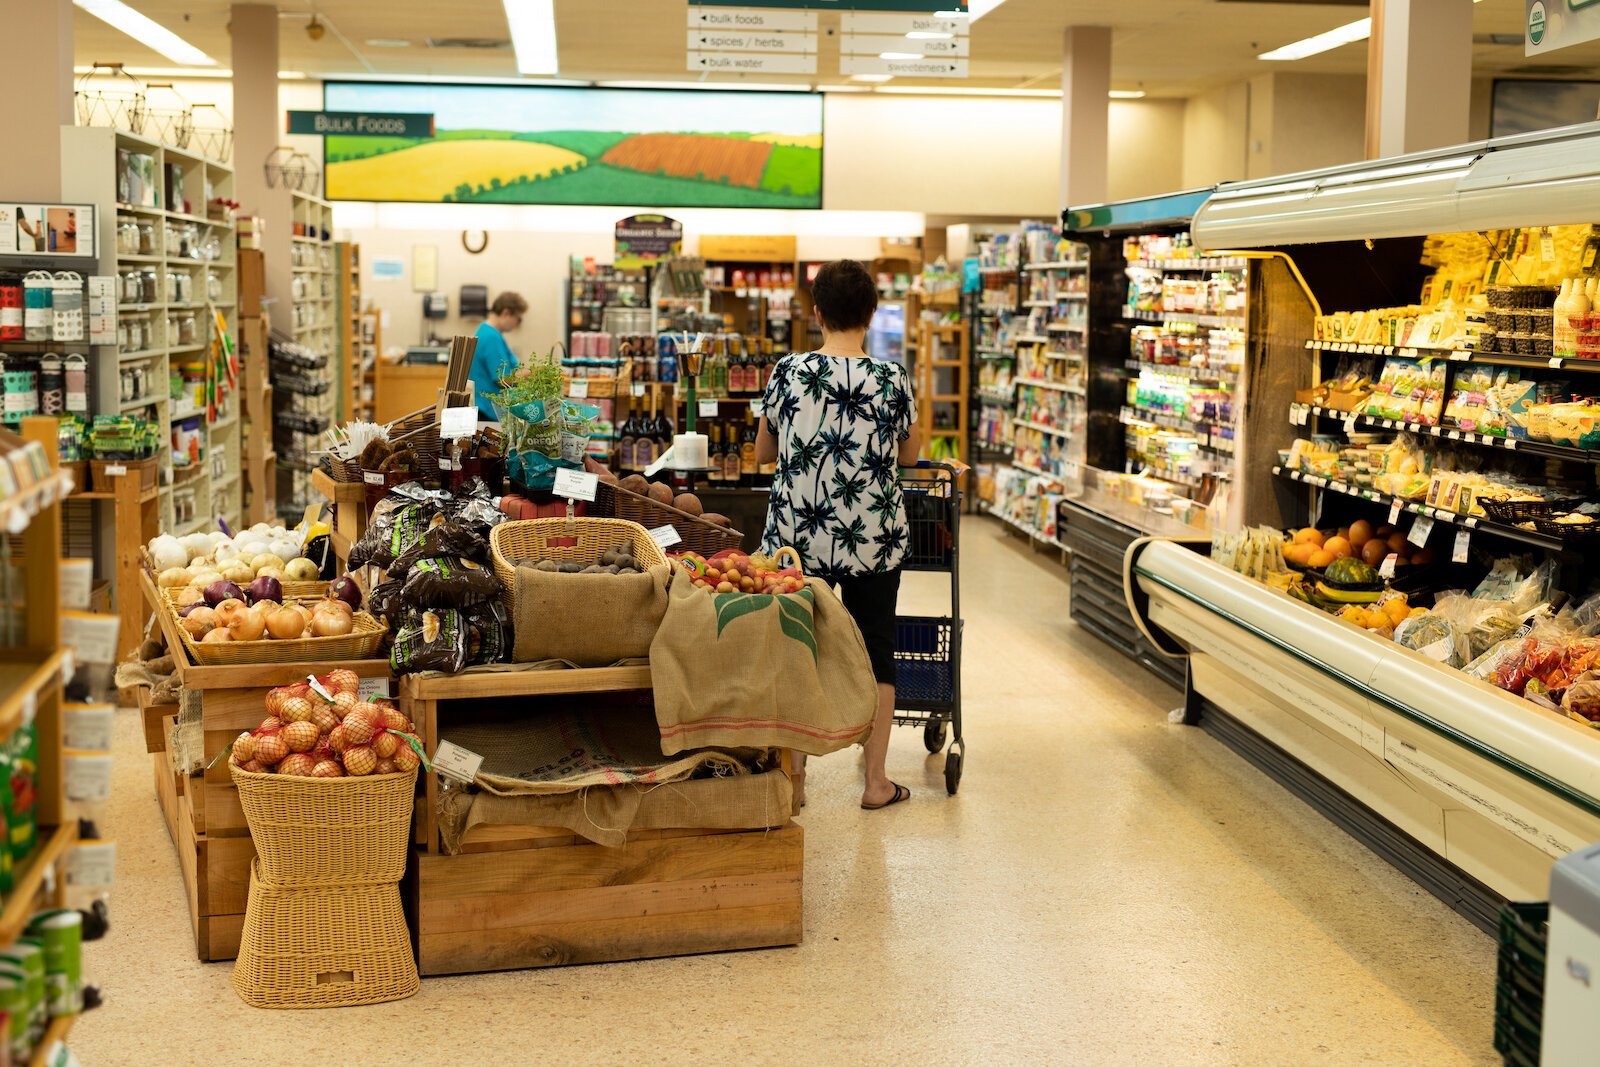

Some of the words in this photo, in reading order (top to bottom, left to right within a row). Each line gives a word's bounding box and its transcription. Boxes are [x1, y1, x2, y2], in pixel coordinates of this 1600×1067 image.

[709, 14, 731, 24] bulk
[735, 14, 764, 25] foods
[912, 19, 948, 32] baking
[710, 36, 744, 48] spices
[754, 37, 784, 48] herbs
[924, 41, 948, 51] nuts
[709, 57, 731, 68] bulk
[735, 58, 764, 69] water
[887, 63, 947, 73] sweeteners
[314, 114, 354, 132] BULK
[357, 115, 406, 133] FOODS
[527, 434, 561, 446] OREGAN
